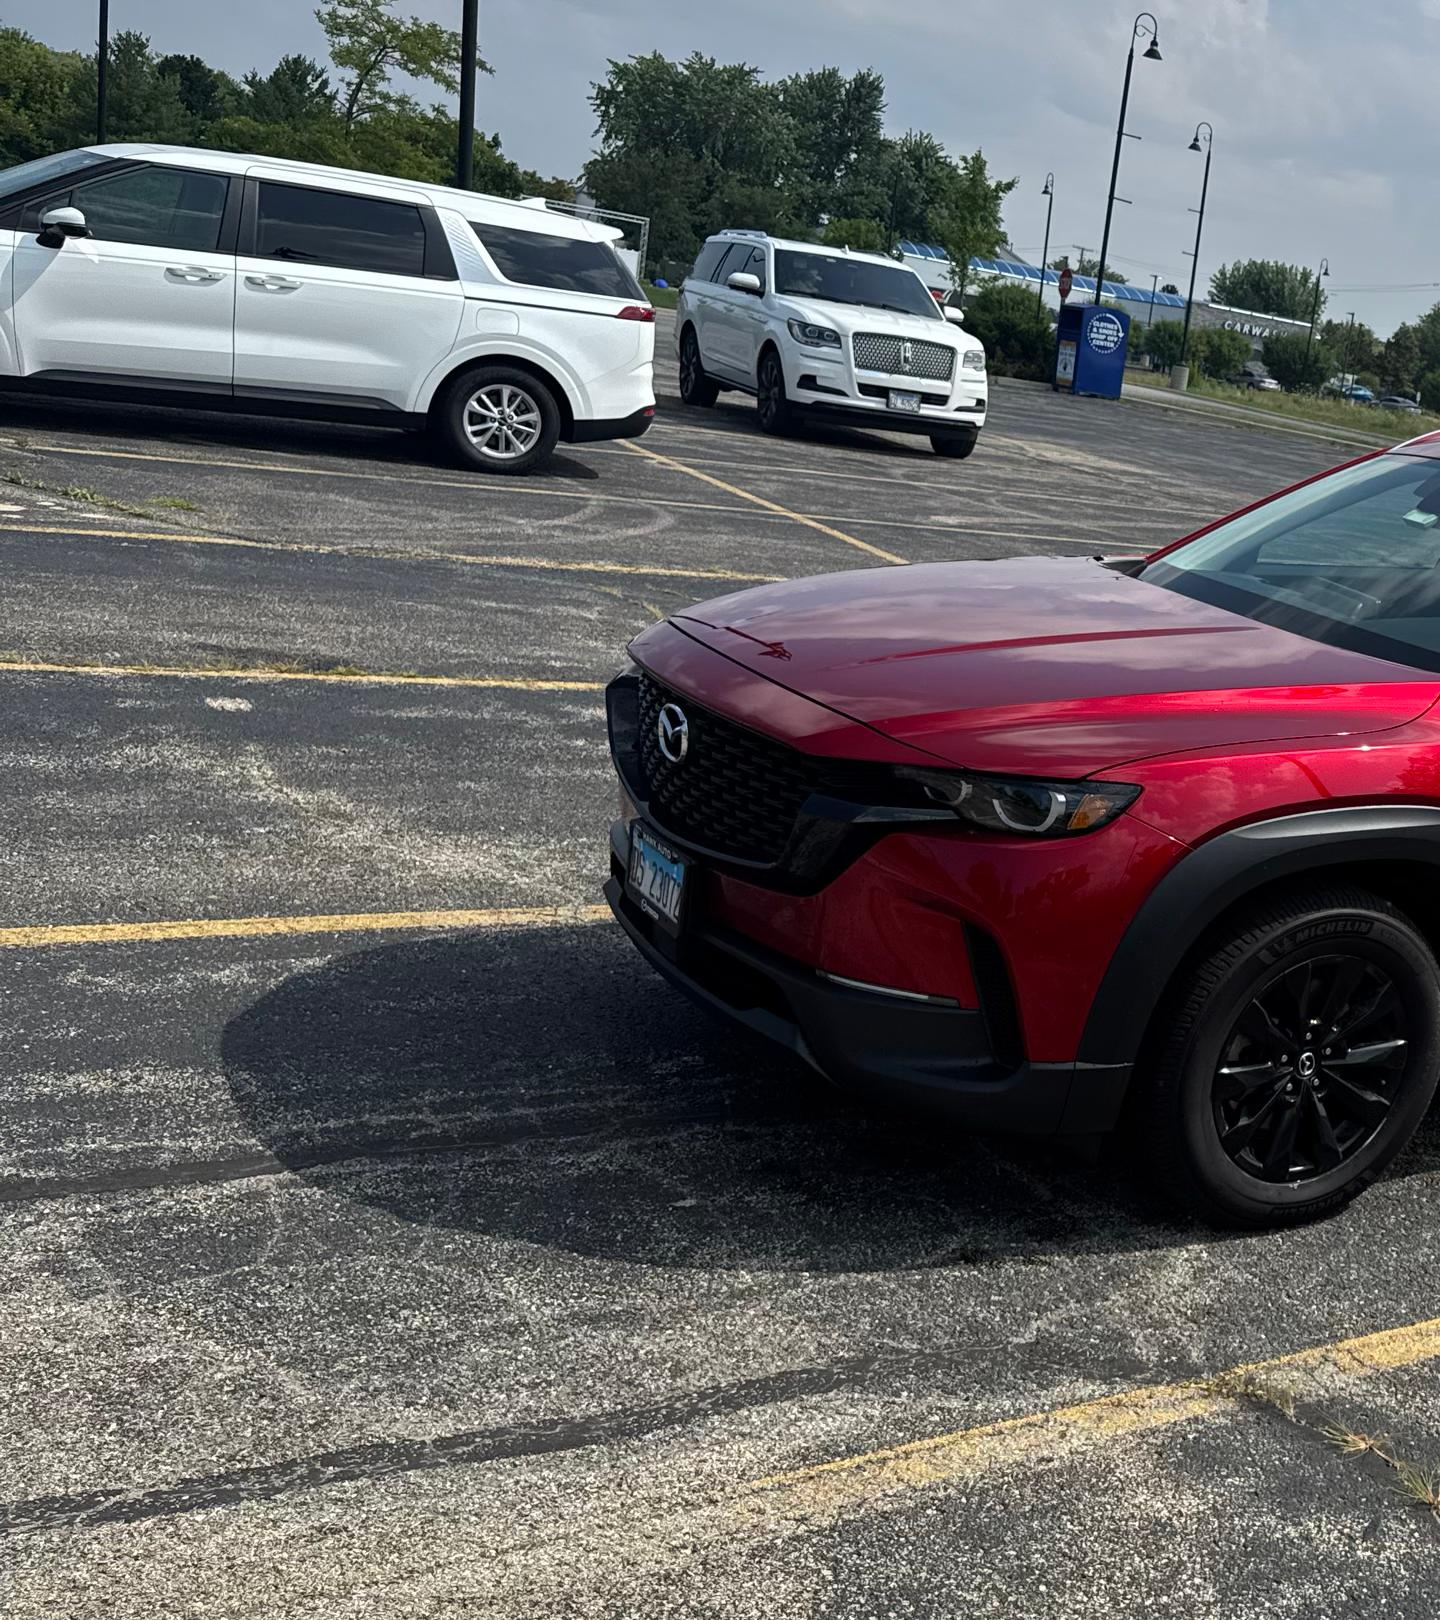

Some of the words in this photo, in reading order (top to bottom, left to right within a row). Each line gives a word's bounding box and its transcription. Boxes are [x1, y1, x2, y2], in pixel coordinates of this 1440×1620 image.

[1092, 339, 1115, 348] CENTER
[657, 842, 672, 860] AUTO
[1296, 920, 1372, 943] MICHELIN
